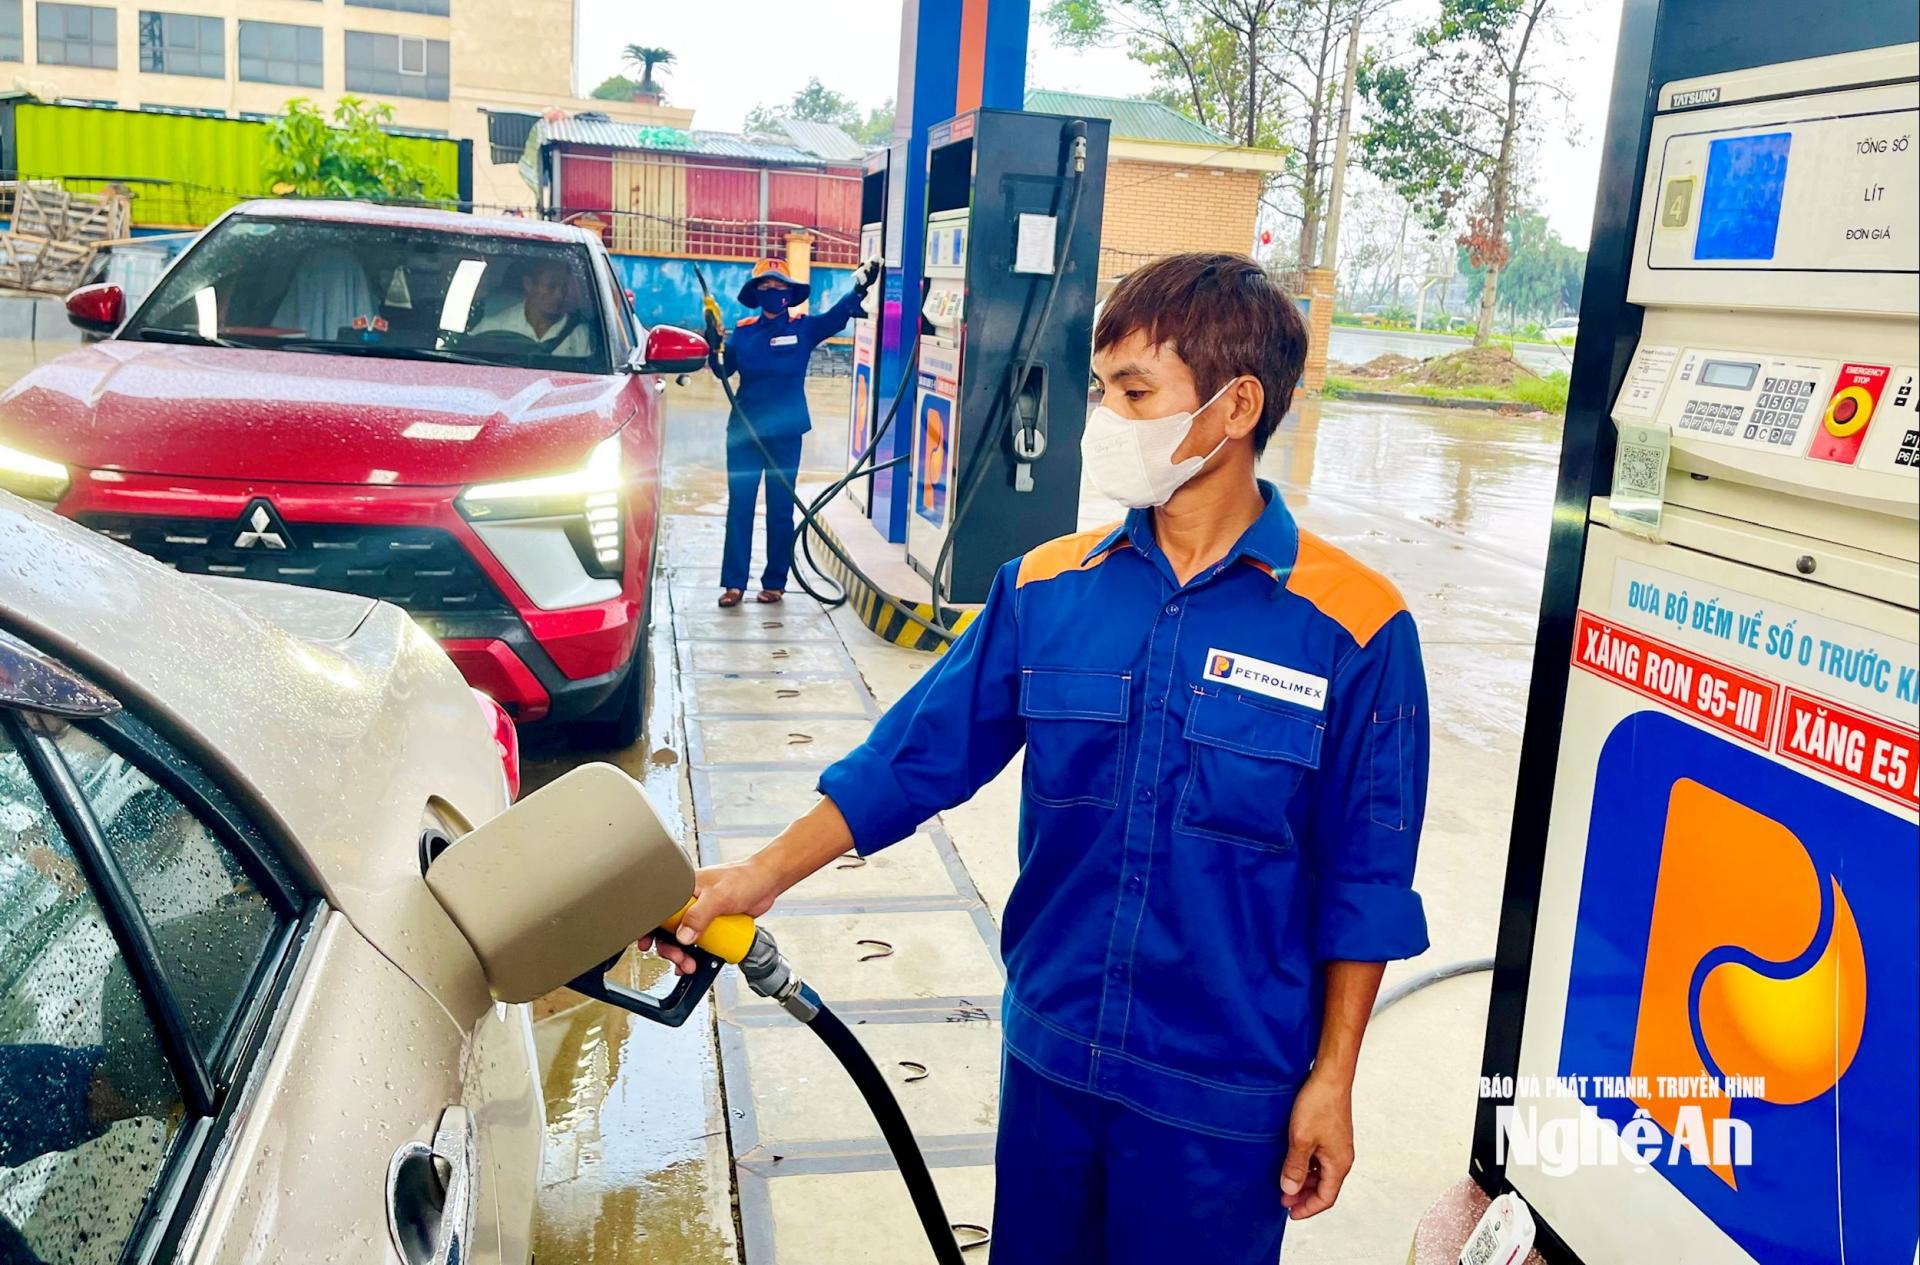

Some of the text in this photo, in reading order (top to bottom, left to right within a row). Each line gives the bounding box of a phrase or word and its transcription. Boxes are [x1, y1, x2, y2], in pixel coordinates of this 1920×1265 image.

[1673, 90, 1718, 106] TATSUNO
[1892, 134, 1911, 152] SỐ
[1864, 183, 1885, 201] LÍT
[1669, 195, 1684, 221] 4
[1845, 225, 1891, 240] ĐƠN GIÁ
[1845, 366, 1885, 376] EMERGENCY
[1765, 379, 1775, 391] 7
[1777, 380, 1785, 392] 8
[1790, 382, 1799, 394] 9
[1853, 376, 1870, 384] STOP
[1687, 402, 1696, 412] P1
[1697, 404, 1707, 413] P2
[1709, 405, 1719, 414] P3
[1731, 408, 1742, 418] P5
[1759, 395, 1768, 406] 4
[1771, 396, 1780, 408] 5
[1783, 398, 1792, 410] 6
[1753, 411, 1761, 421] 1
[1765, 412, 1775, 424] 2
[1777, 414, 1786, 425] 3
[1746, 425, 1756, 437] 0
[1759, 428, 1768, 440] C
[1904, 434, 1917, 444] P1
[1897, 451, 1911, 462] P6
[1628, 580, 1660, 616] ĐƯA
[1665, 590, 1689, 631] BỘ
[1692, 597, 1733, 640] ĐẾM
[1738, 609, 1764, 650] VỀ
[1765, 619, 1798, 661] SỐ
[1819, 640, 1891, 694] TRƯỚC
[1235, 666, 1323, 699] PETROLIMEX
[1583, 626, 1763, 733] XĂNG RON 95-III
[1790, 706, 1866, 775] XĂNG
[1870, 738, 1909, 791] E5
